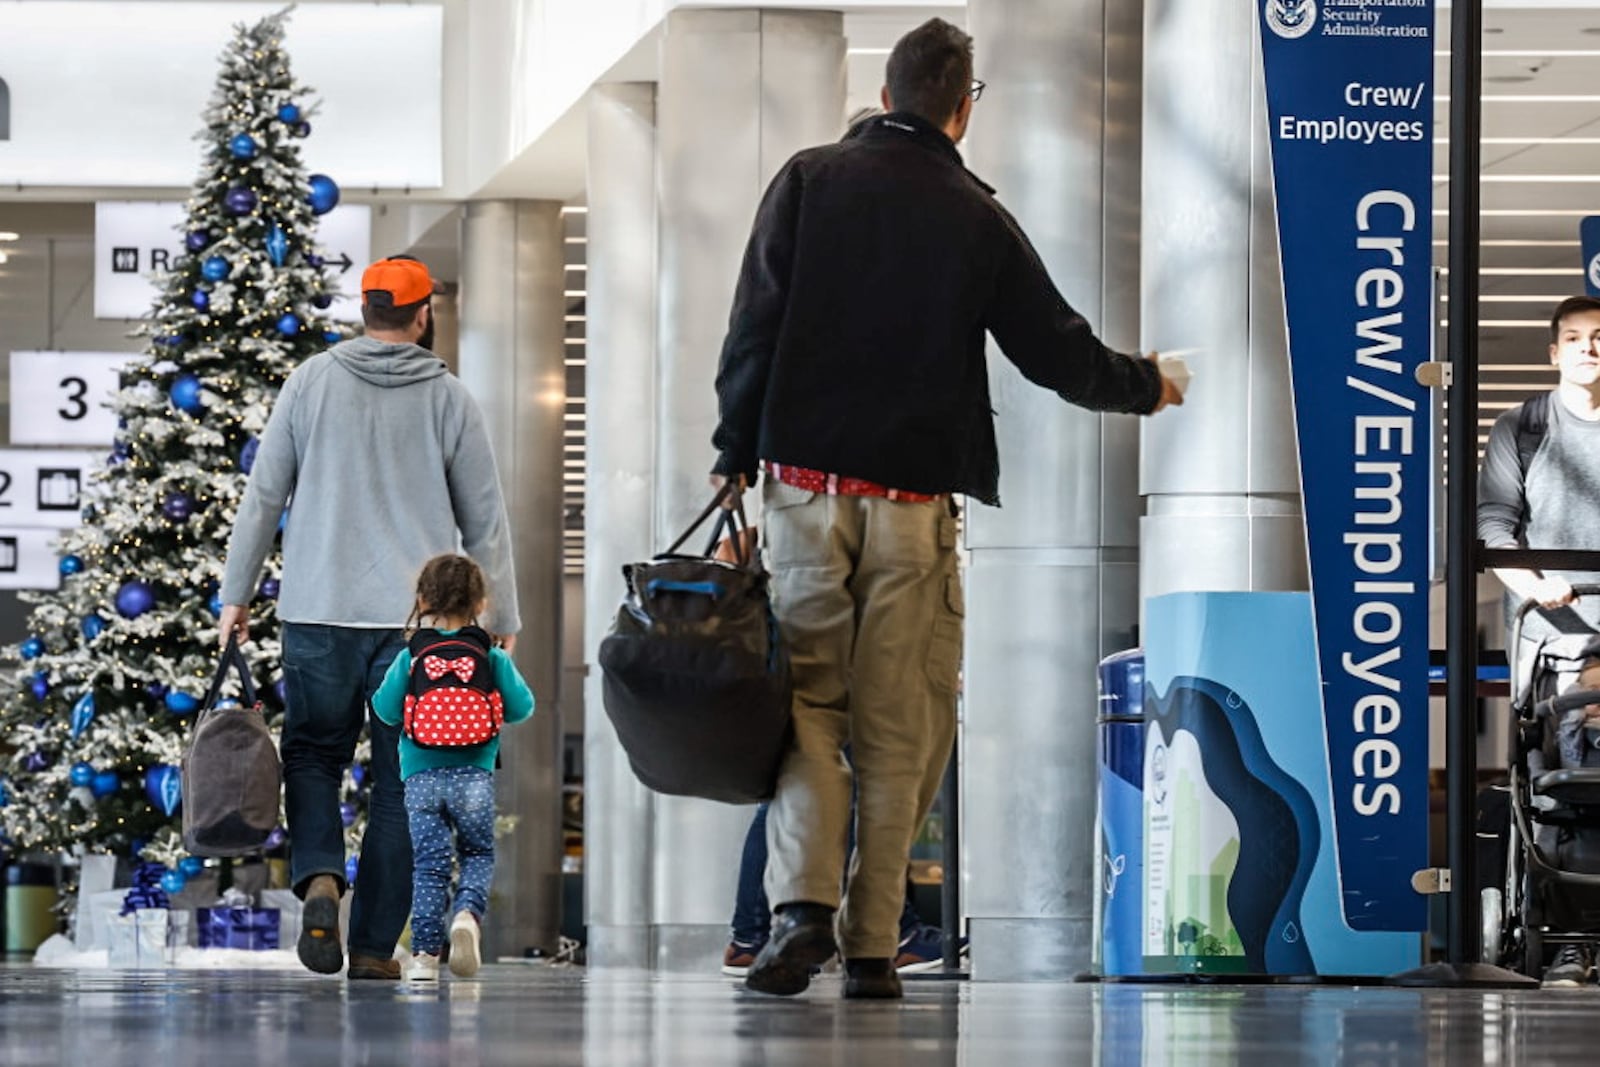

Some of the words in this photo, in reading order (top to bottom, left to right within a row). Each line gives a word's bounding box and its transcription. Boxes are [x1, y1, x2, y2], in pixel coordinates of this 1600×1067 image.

[1321, 22, 1428, 37] Administration
[1322, 8, 1381, 24] Security
[1344, 82, 1424, 110] Crew/
[1279, 116, 1424, 144] Employees
[58, 376, 88, 421] 3
[1342, 190, 1416, 816] Crew/Employees
